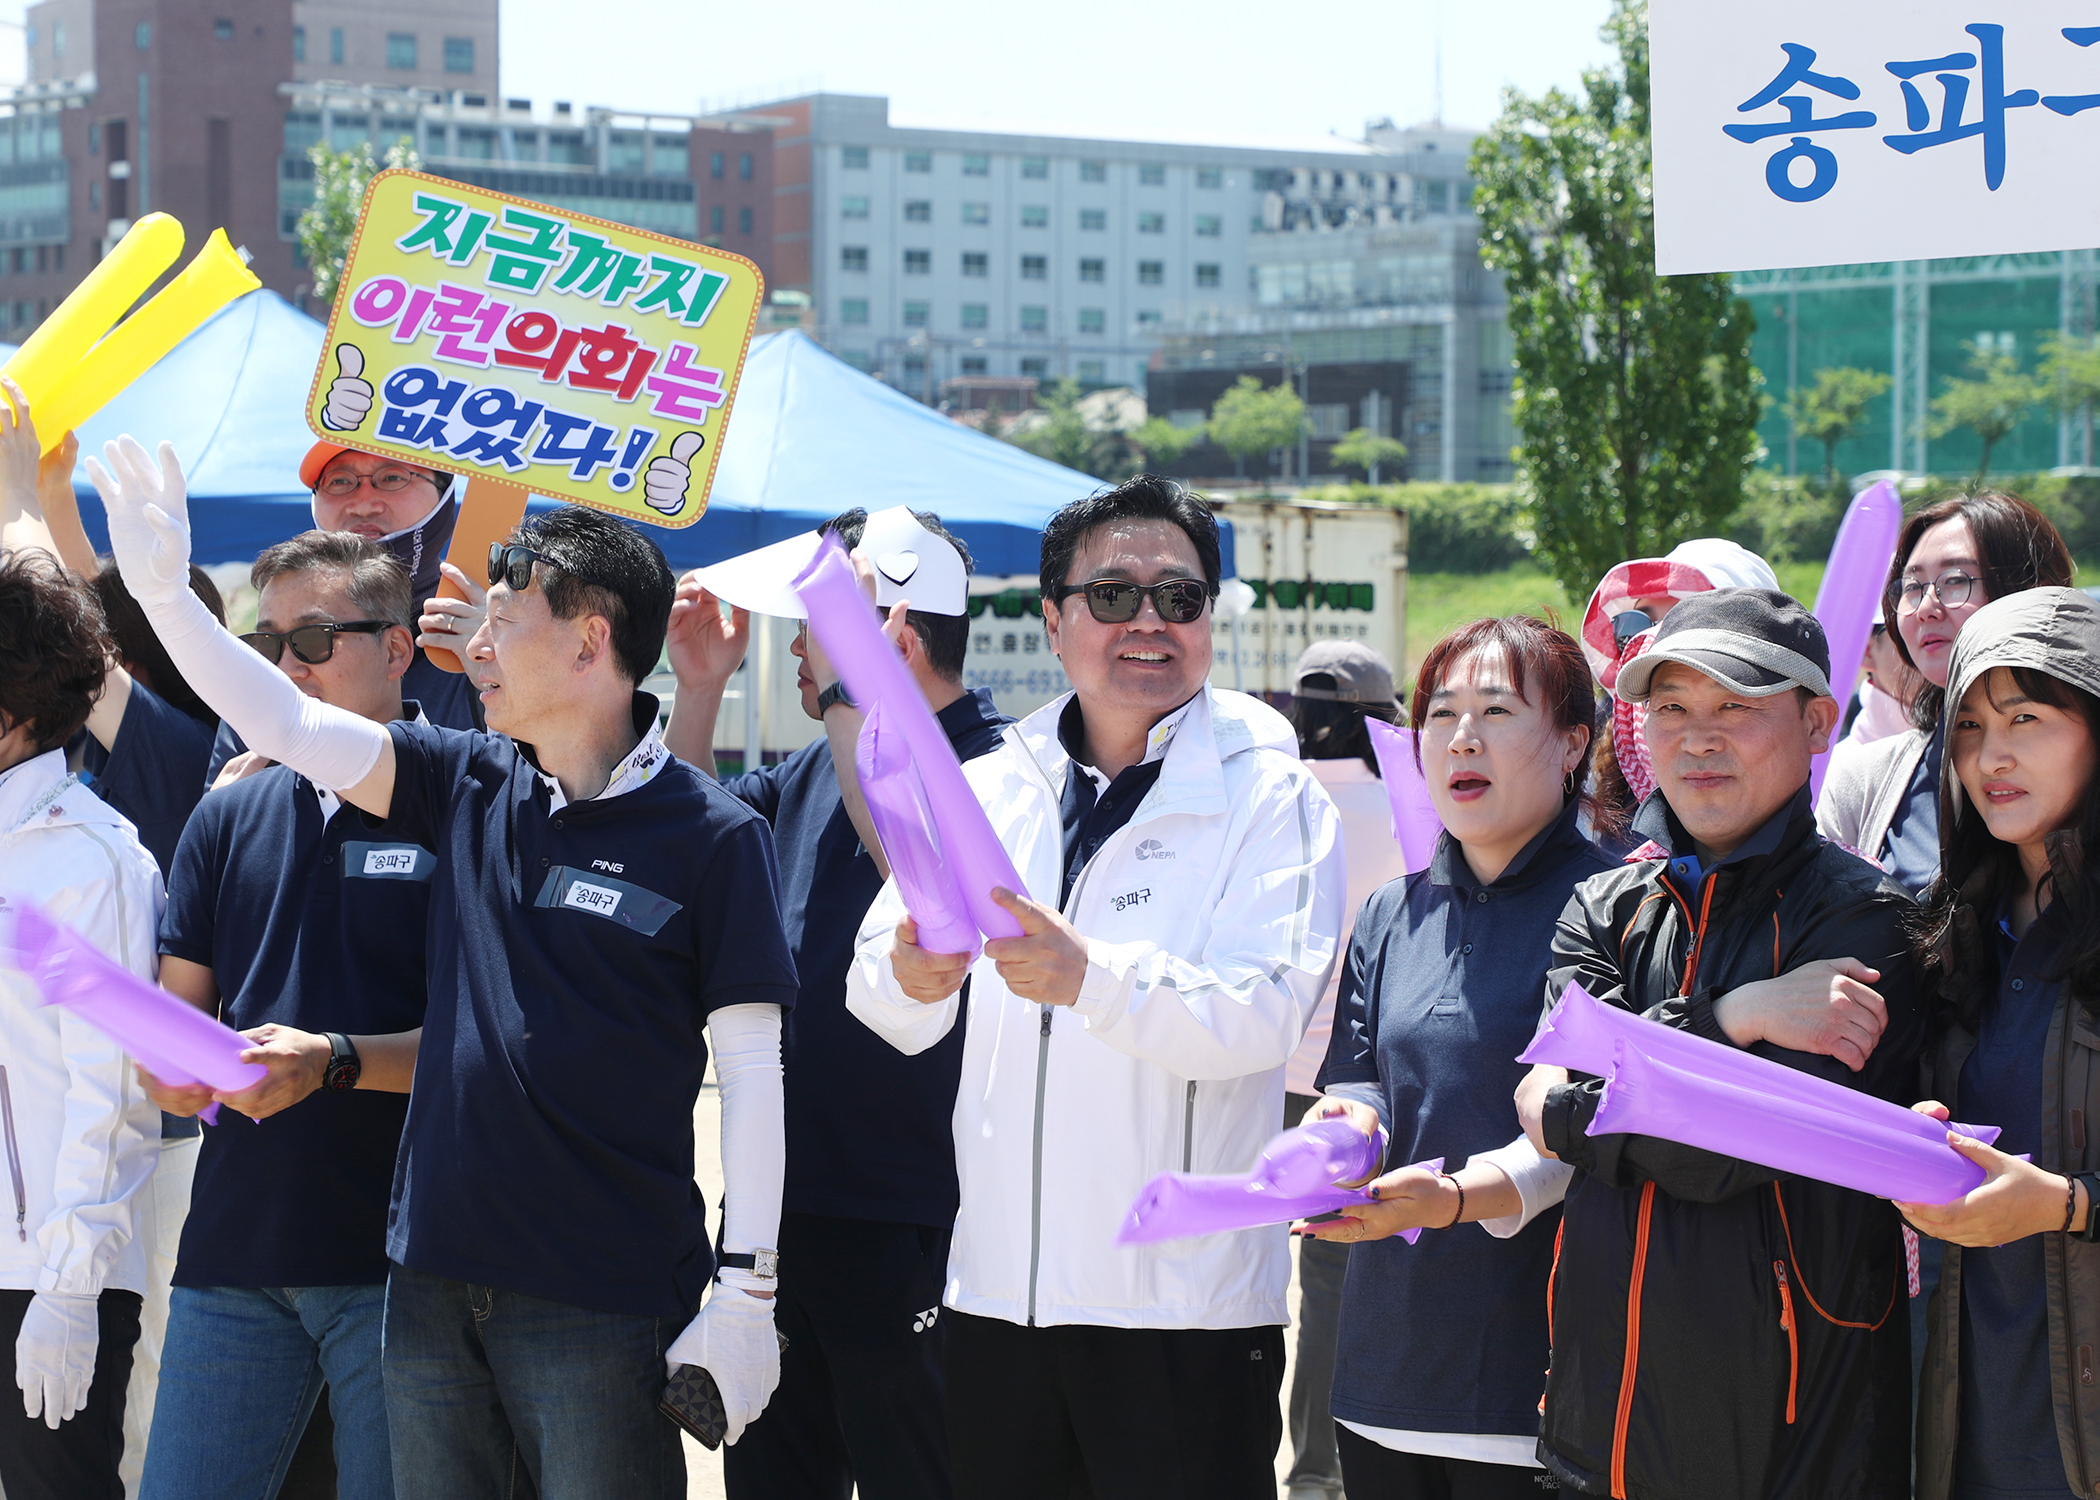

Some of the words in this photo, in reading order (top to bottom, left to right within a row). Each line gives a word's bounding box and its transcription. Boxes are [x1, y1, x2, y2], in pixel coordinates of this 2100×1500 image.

[399, 193, 728, 324] 지금까지
[377, 366, 654, 491] 없었다!
[374, 854, 411, 871] 송파구
[590, 858, 626, 875] PING
[1151, 851, 1176, 859] NEPA
[576, 887, 615, 910] 송파구
[1115, 888, 1152, 912] 송파구
